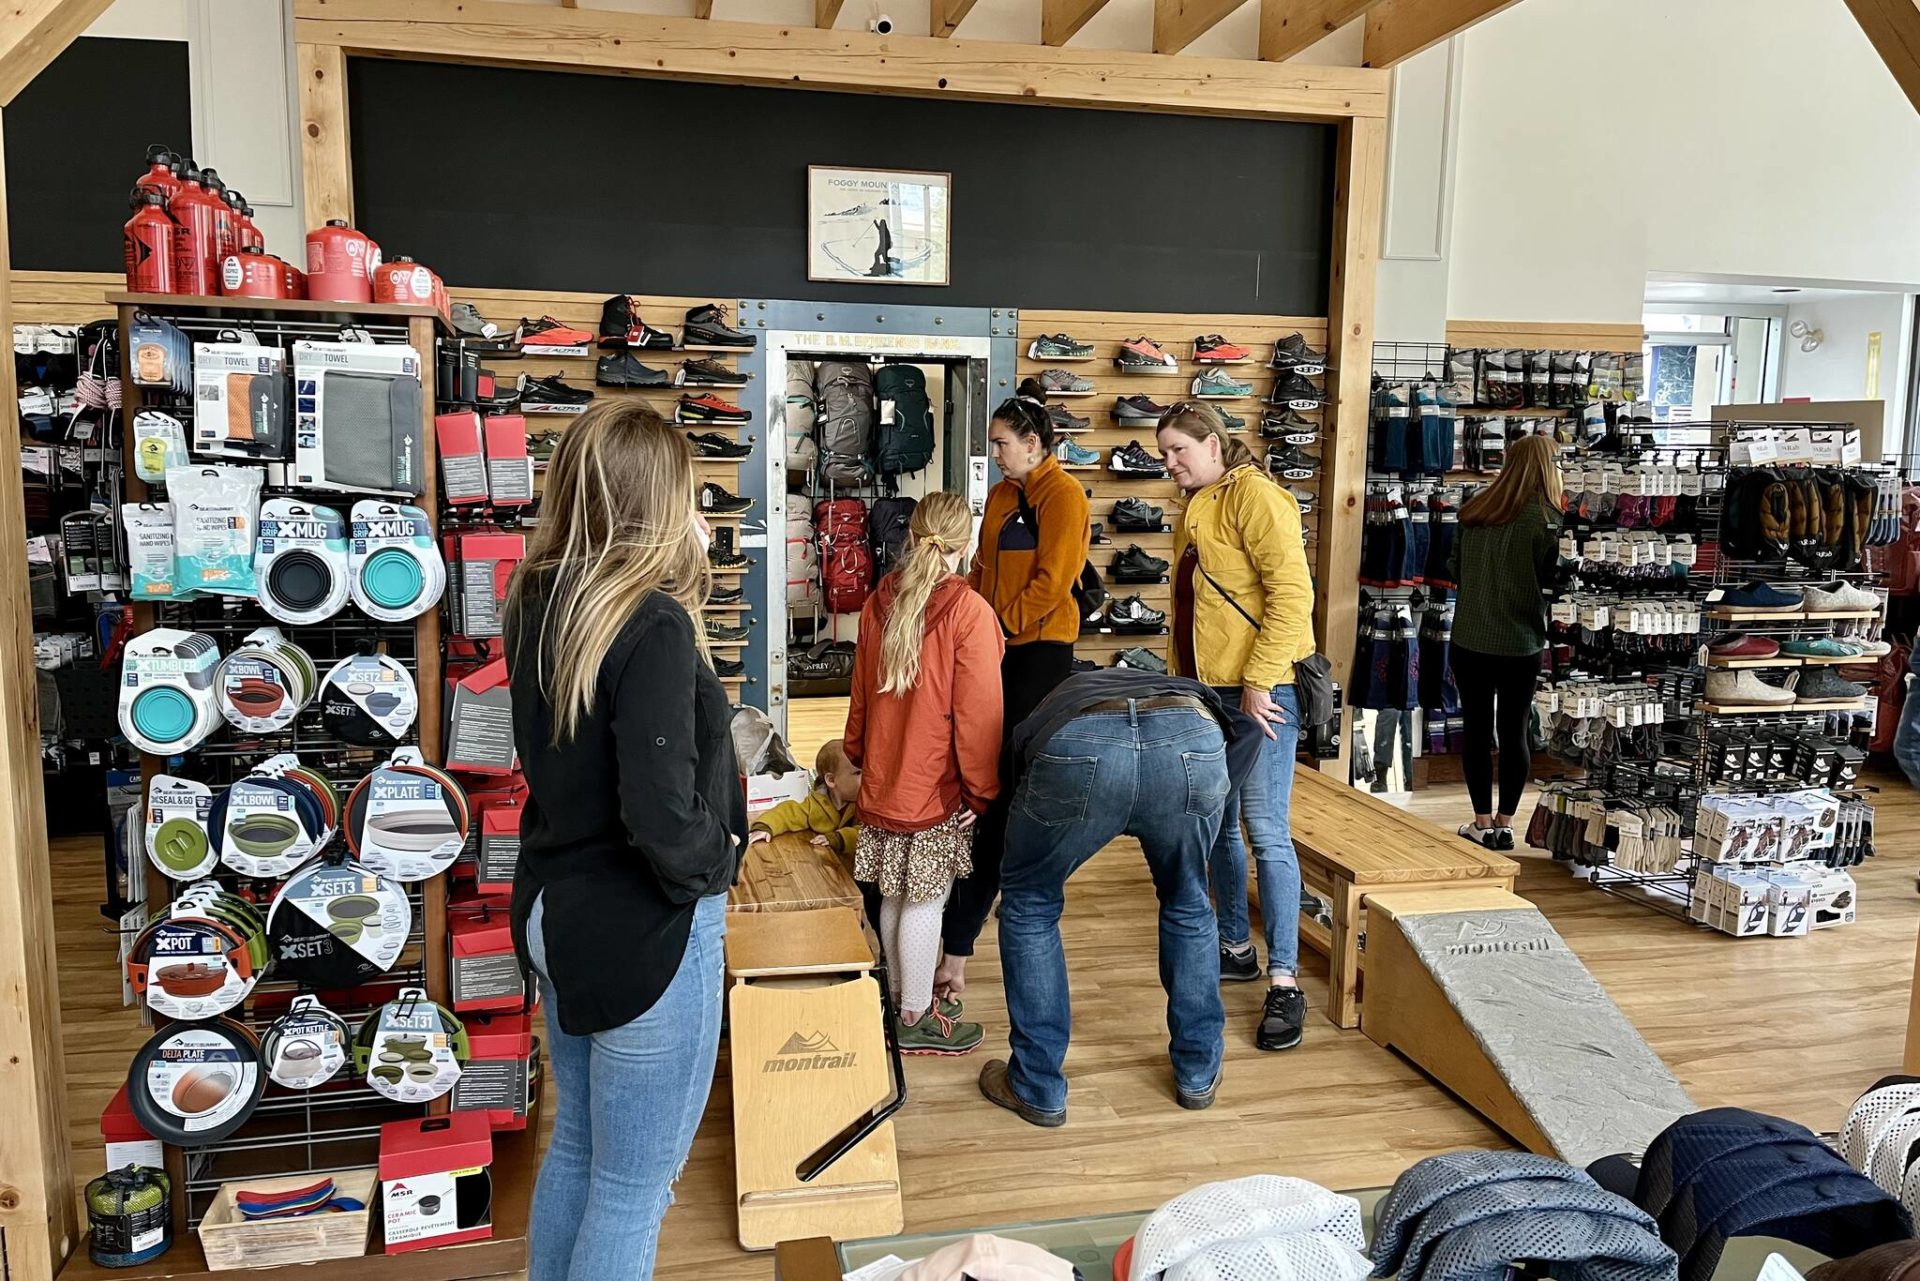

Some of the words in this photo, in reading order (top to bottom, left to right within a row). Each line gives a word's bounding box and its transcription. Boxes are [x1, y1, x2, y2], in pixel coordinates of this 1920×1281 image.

[828, 179, 859, 188] FOGGY
[795, 334, 821, 346] THE
[225, 356, 250, 366] TOWEL
[324, 353, 348, 364] TOWEL
[352, 522, 368, 530] COOL
[352, 530, 368, 538] GRIP
[178, 796, 183, 804] &
[184, 796, 193, 804] GO
[1446, 938, 1550, 956] montrail
[306, 1024, 330, 1033] KETTLE
[162, 1050, 182, 1058] DELTA
[183, 1050, 205, 1058] PLATE
[762, 1052, 857, 1074] montrail
[390, 1190, 413, 1198] MSR
[388, 1210, 416, 1219] CERAMIC
[388, 1227, 419, 1236] CASSEROLE
[421, 1220, 455, 1230] REVÊTEMENT
[388, 1232, 422, 1242] CÉRAMIQUE
